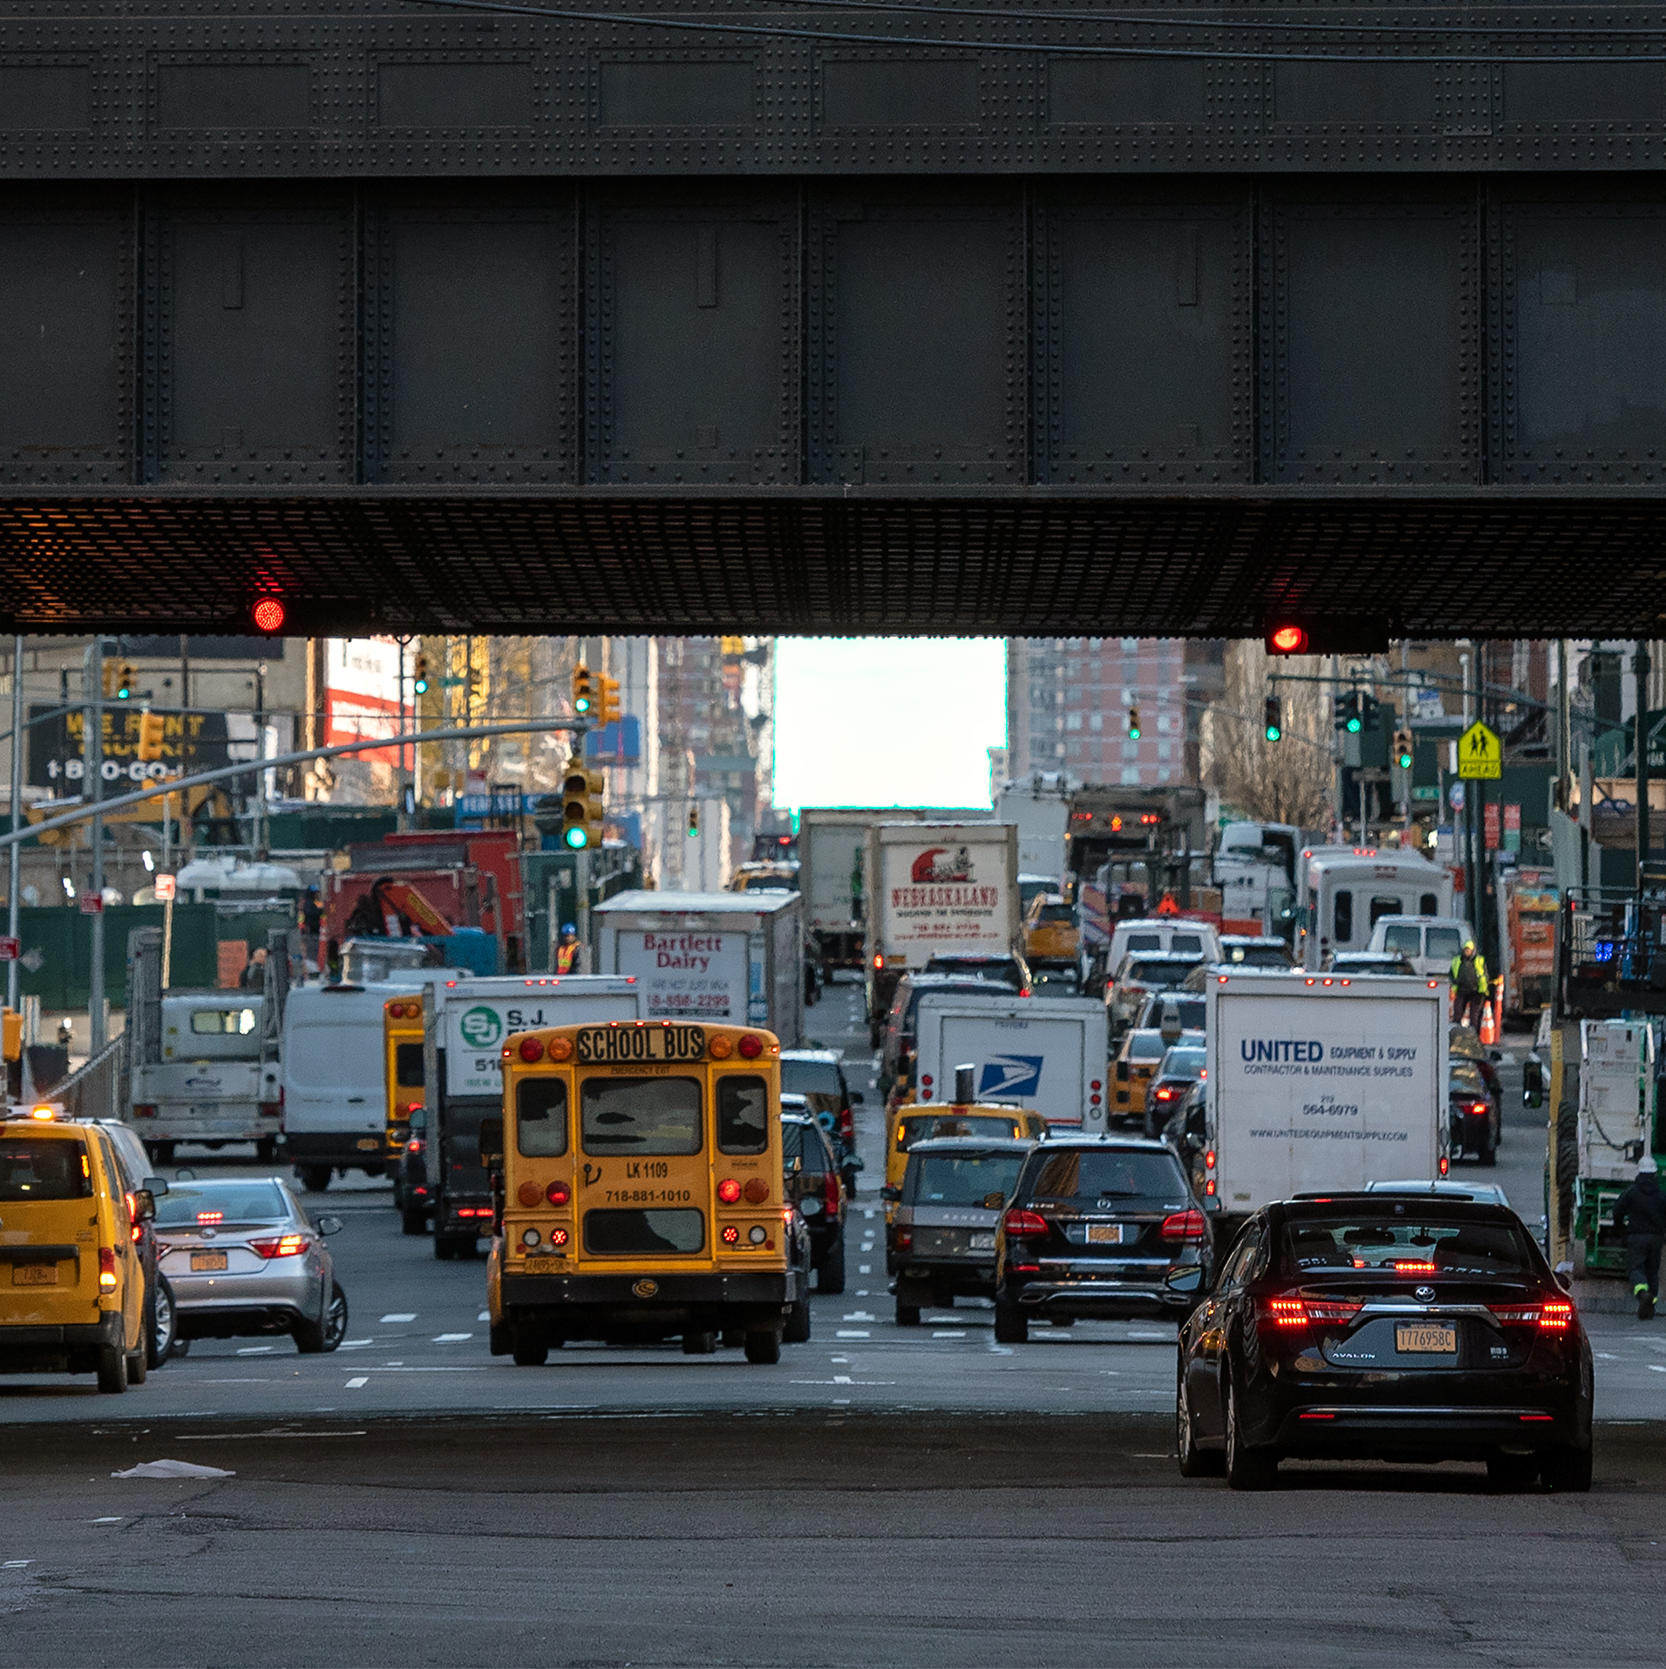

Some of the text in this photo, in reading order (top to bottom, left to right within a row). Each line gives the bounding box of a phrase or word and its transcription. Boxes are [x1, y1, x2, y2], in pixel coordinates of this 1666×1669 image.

[892, 888, 999, 908] NEBRASKALAND
[643, 933, 722, 953] Bartlett
[657, 952, 710, 973] Dairy
[579, 1028, 703, 1059] SCHOOL BUS
[1241, 1040, 1324, 1062] UNITED
[1330, 1047, 1375, 1059] EQUIPMENT
[1387, 1048, 1417, 1060] SUPPLY
[1244, 1065, 1302, 1076] CONTRACTOR
[1311, 1065, 1371, 1077] MAINTENANCE
[1373, 1066, 1414, 1077] SUPPLIES
[627, 1162, 668, 1178] LK 1109
[606, 1190, 690, 1202] 718-881-1010
[1400, 1331, 1452, 1347] T776958C
[1332, 1352, 1376, 1361] AVALON
